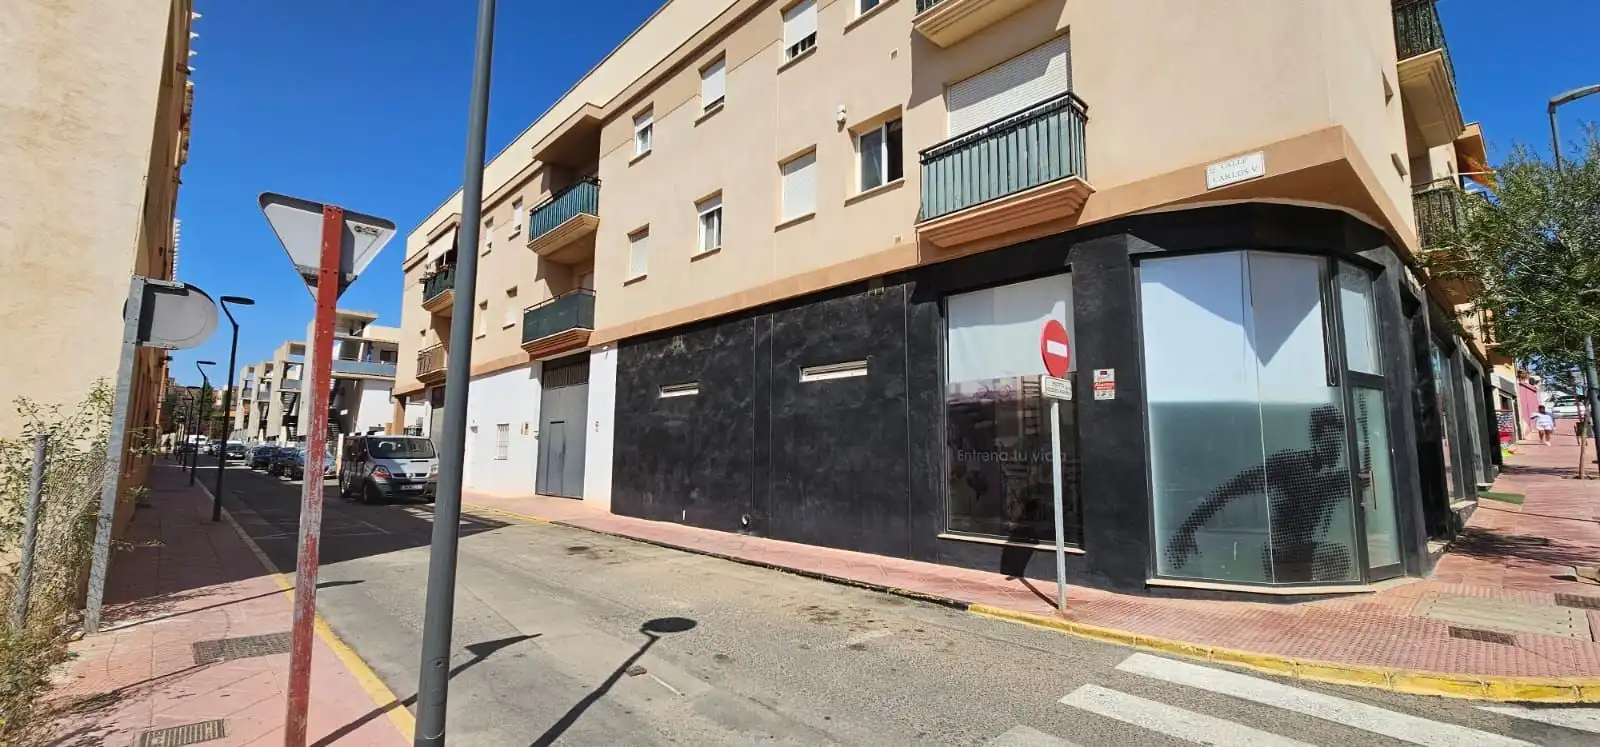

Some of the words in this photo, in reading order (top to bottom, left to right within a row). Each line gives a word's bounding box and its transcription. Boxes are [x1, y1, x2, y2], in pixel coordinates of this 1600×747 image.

[1213, 168, 1249, 183] CARLOS
[958, 449, 1009, 462] Entrena
[1013, 449, 1027, 461] tu
